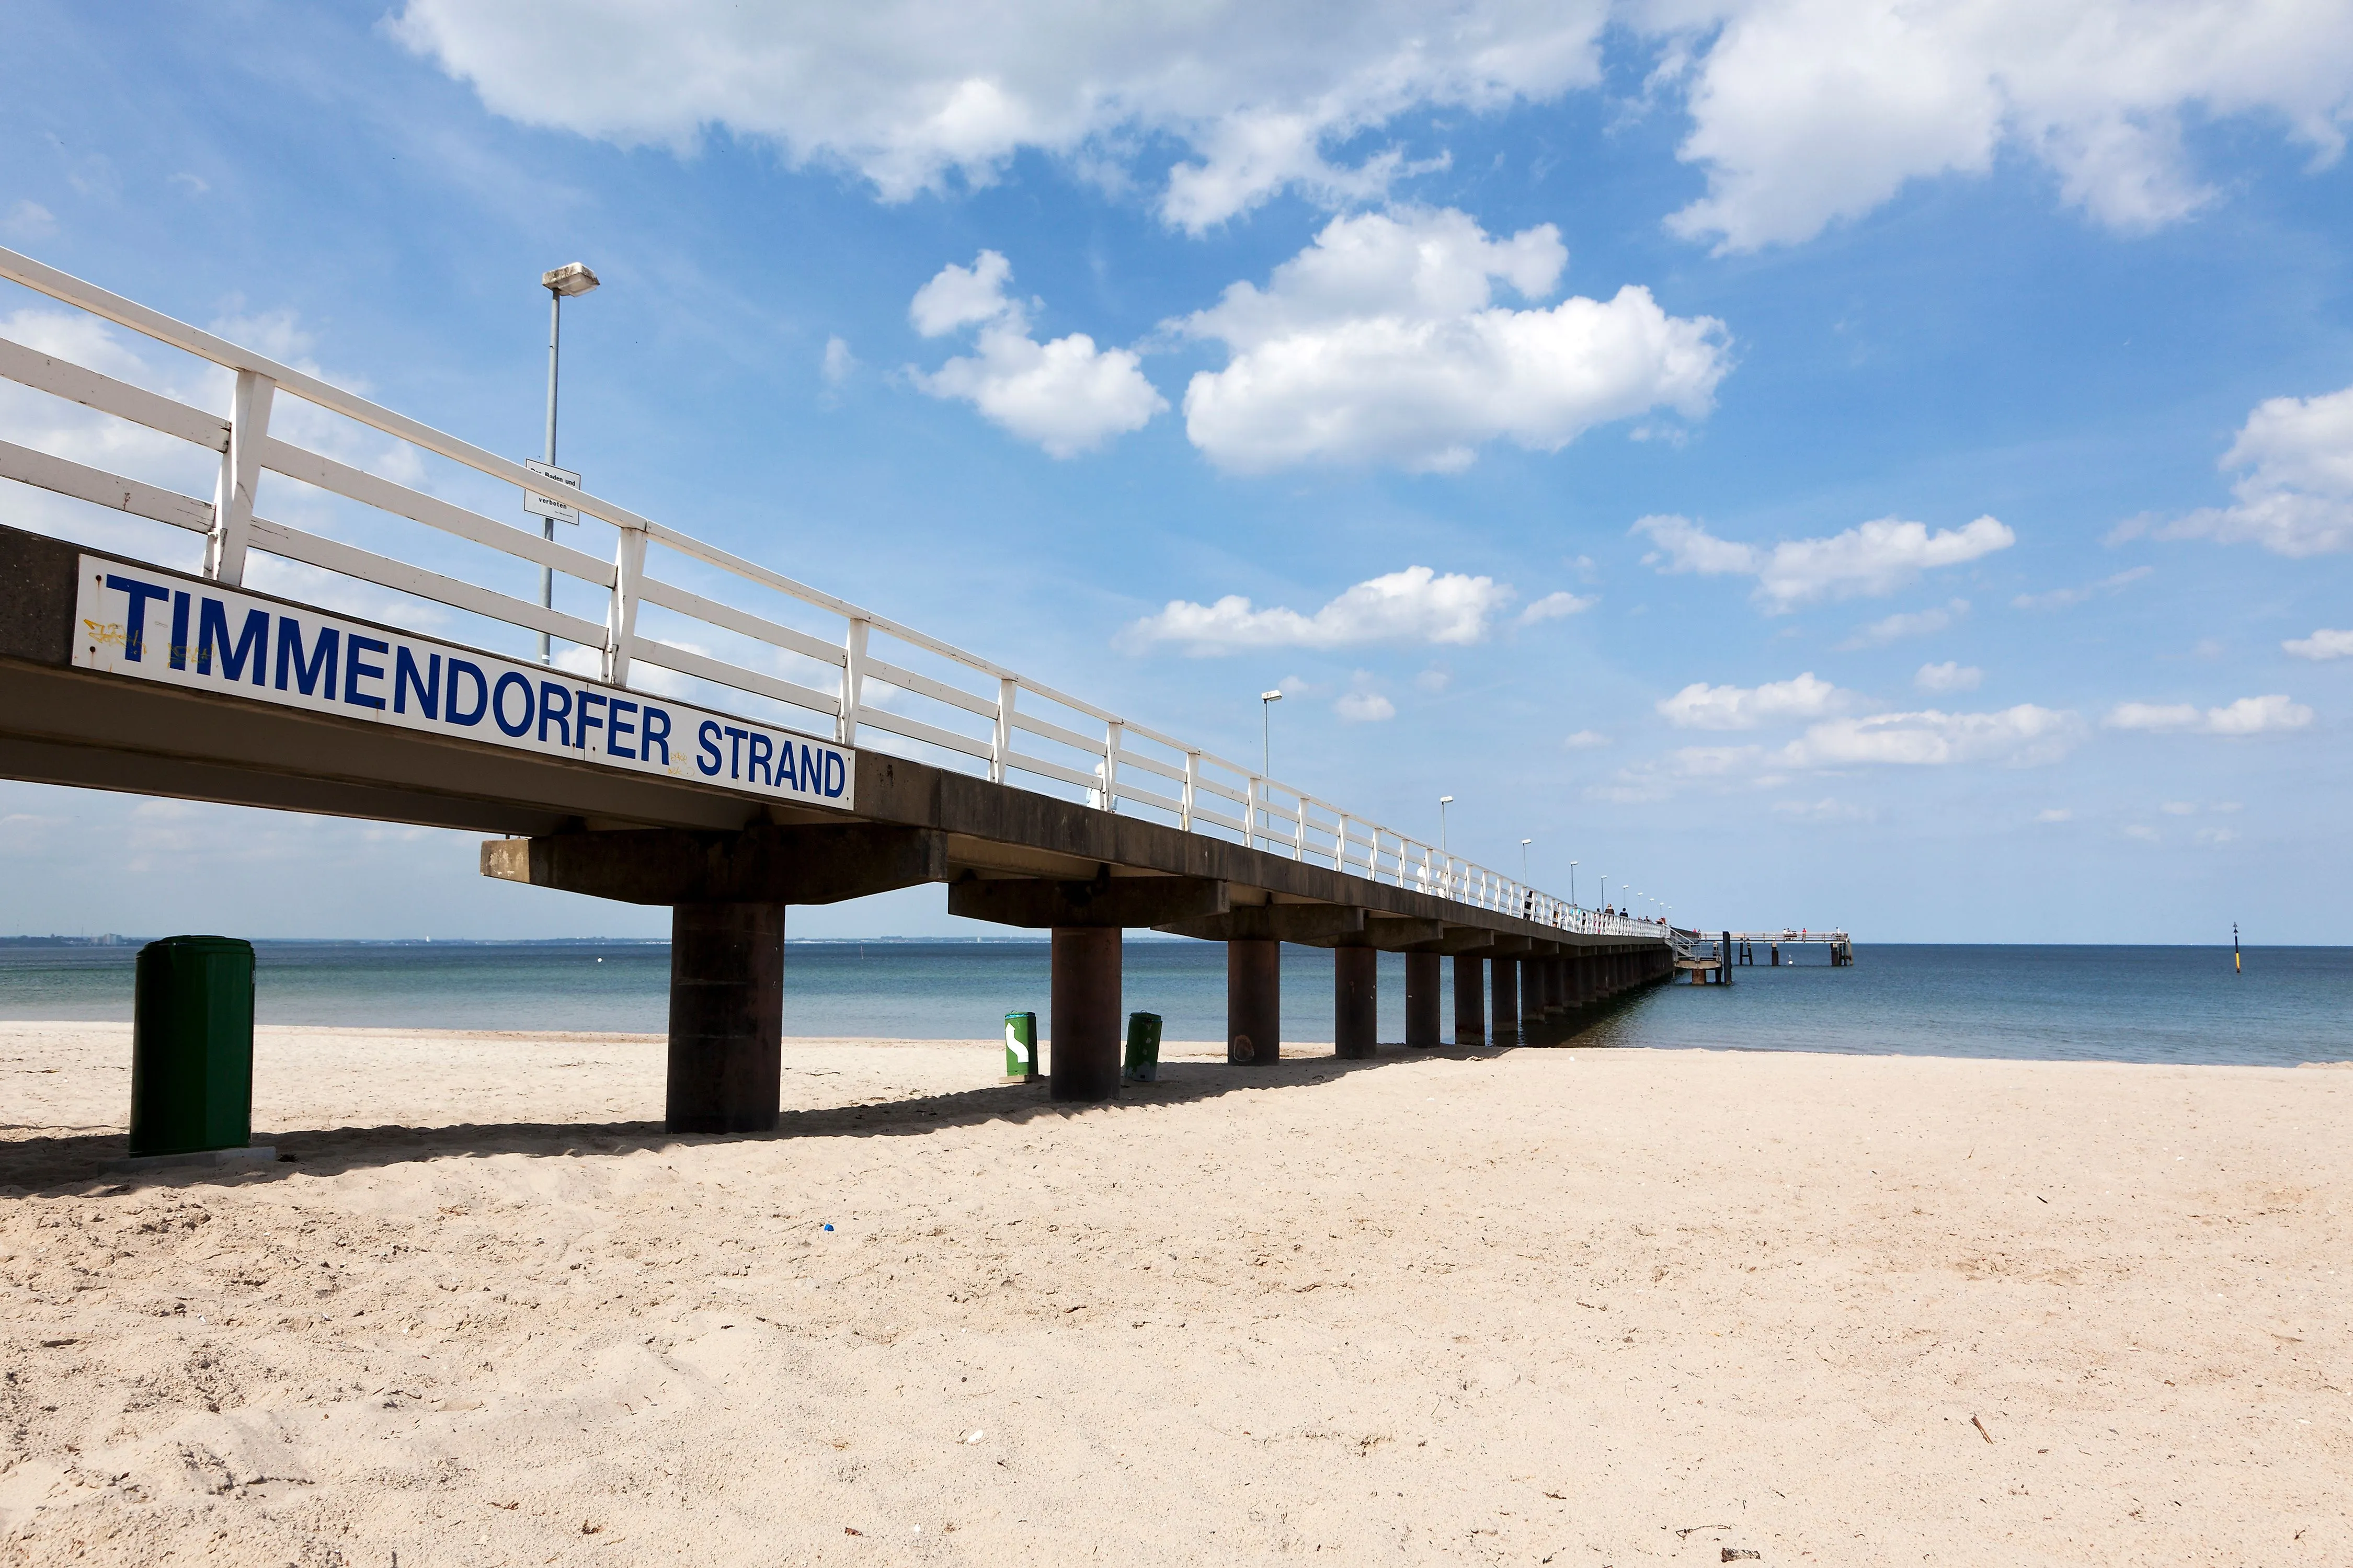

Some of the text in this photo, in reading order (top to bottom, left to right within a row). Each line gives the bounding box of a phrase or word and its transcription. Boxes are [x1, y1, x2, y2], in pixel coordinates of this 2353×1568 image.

[539, 497, 567, 509] verboten
[107, 574, 846, 798] TIMMENDORFER STRAND
